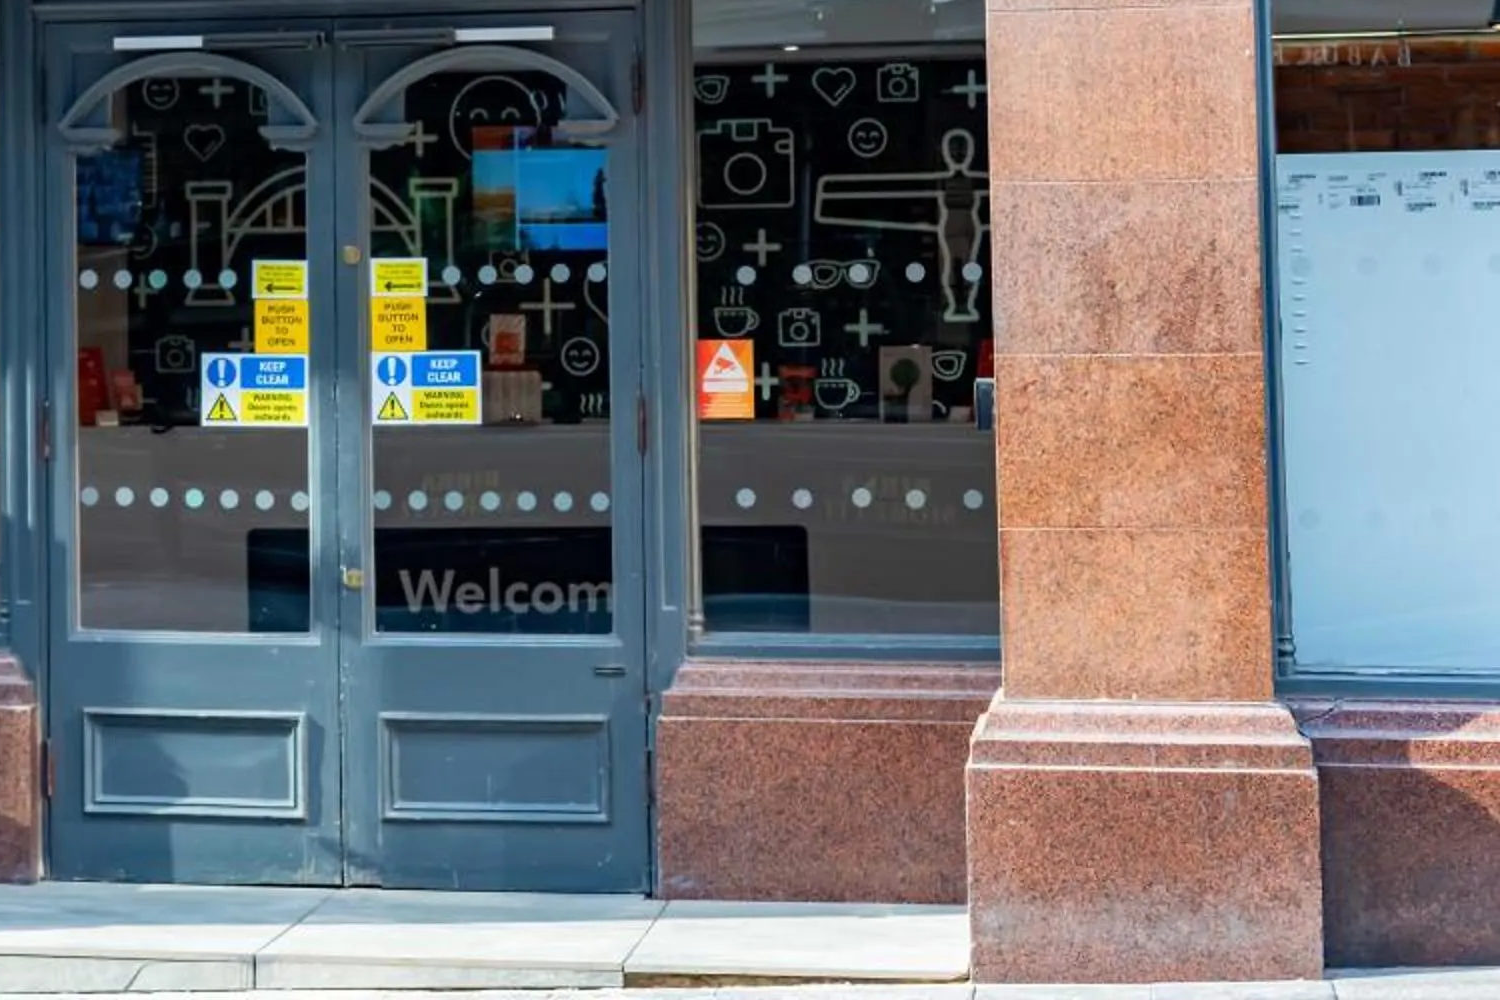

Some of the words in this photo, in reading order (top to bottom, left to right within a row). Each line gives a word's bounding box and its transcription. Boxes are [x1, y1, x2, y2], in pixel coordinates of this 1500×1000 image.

[267, 305, 296, 314] PUSH
[261, 316, 302, 325] BUTTON
[377, 313, 419, 322] BUTTON
[275, 326, 289, 335] TO
[392, 324, 406, 333] TO
[267, 338, 296, 347] OPEN
[384, 335, 413, 345] OPEN
[259, 361, 287, 372] KEEP
[430, 359, 458, 370] KEEP
[255, 375, 289, 385] CLEAR
[427, 372, 461, 383] CLEAR
[398, 566, 613, 614] Welcom
